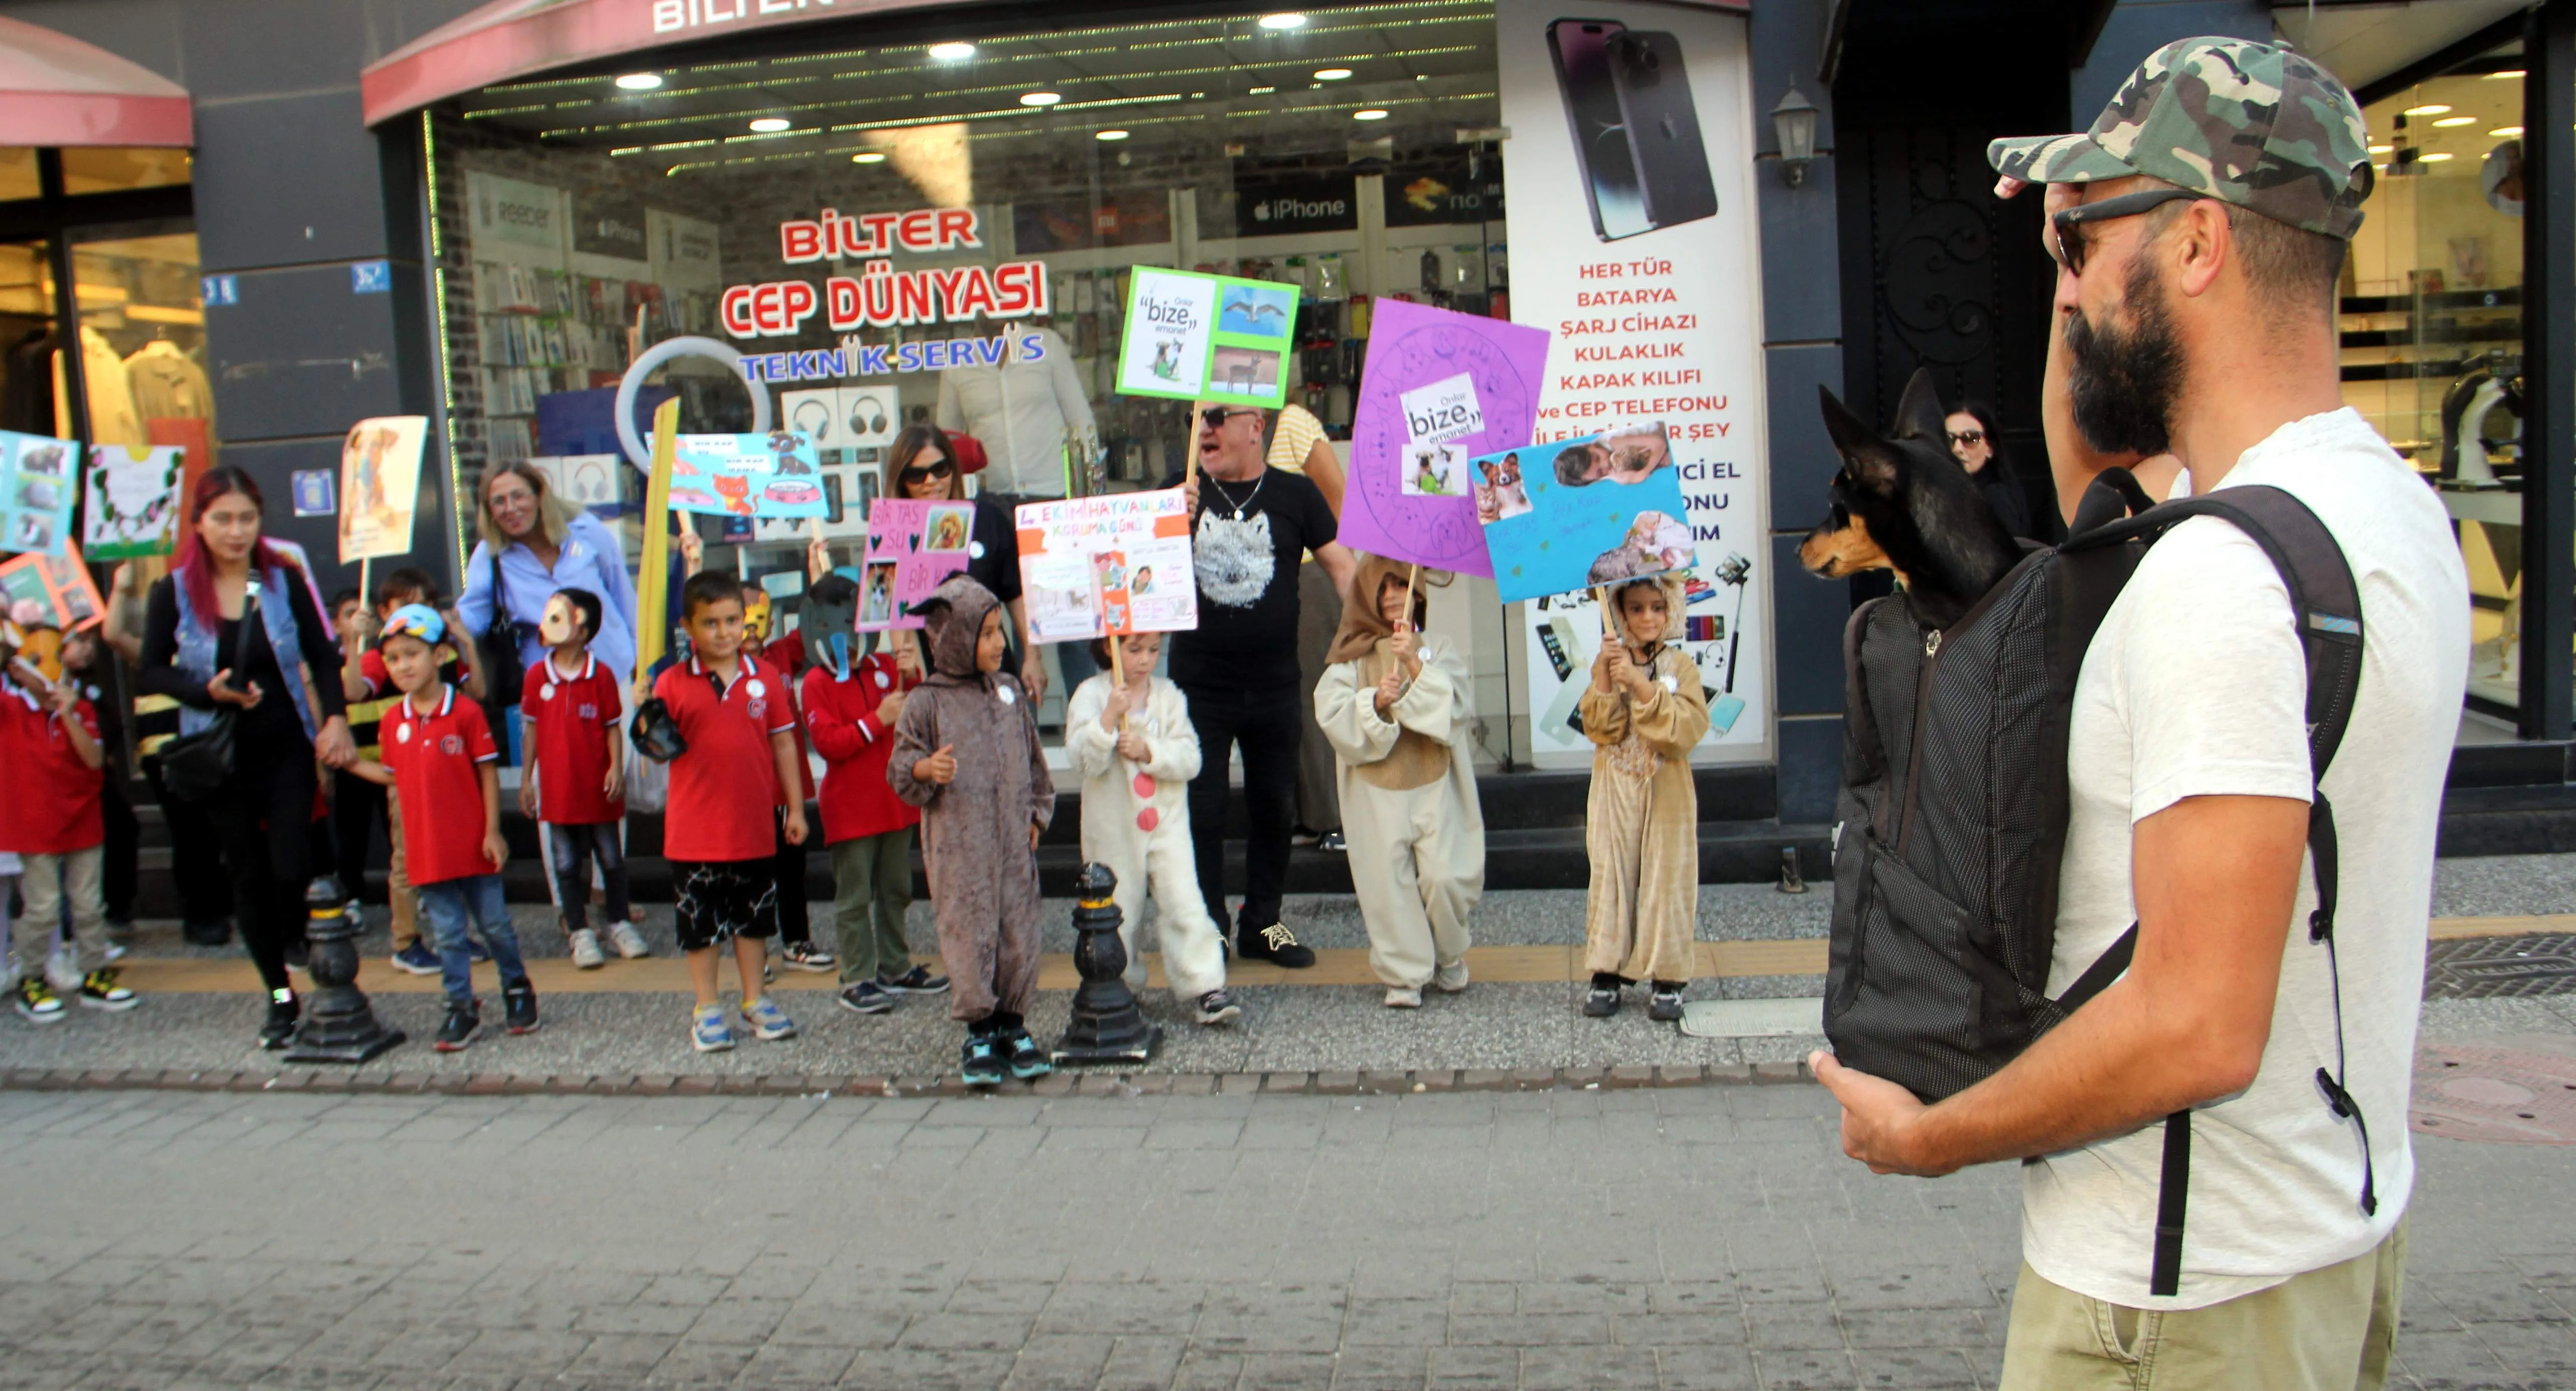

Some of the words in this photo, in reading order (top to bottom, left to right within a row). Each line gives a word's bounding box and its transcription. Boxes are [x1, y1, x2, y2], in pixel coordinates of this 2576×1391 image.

[1273, 200, 1346, 220] iPhone
[780, 208, 982, 263] BİLTER
[1580, 263, 1623, 279] HER
[1628, 257, 1672, 277] TÜR
[722, 281, 817, 338] CEP
[826, 260, 1048, 331] DÜNYASI
[1577, 288, 1677, 307] BATARYA
[1155, 325, 1187, 335] emanet
[1560, 318, 1616, 339] ŞARJ
[1622, 312, 1697, 332] CİHAZI
[1574, 342, 1685, 362] KULAKLIK
[1560, 372, 1636, 390] KAPAK
[1642, 369, 1701, 386] KILIFI
[1440, 392, 1466, 407] Onlar
[1537, 406, 1560, 419] ve
[1565, 401, 1606, 417] CEP
[1612, 395, 1728, 415] TELEFONU
[1429, 423, 1473, 444] emanet
[1688, 422, 1731, 443] ŞEY
[1712, 462, 1742, 479] EL
[886, 528, 906, 550] SU
